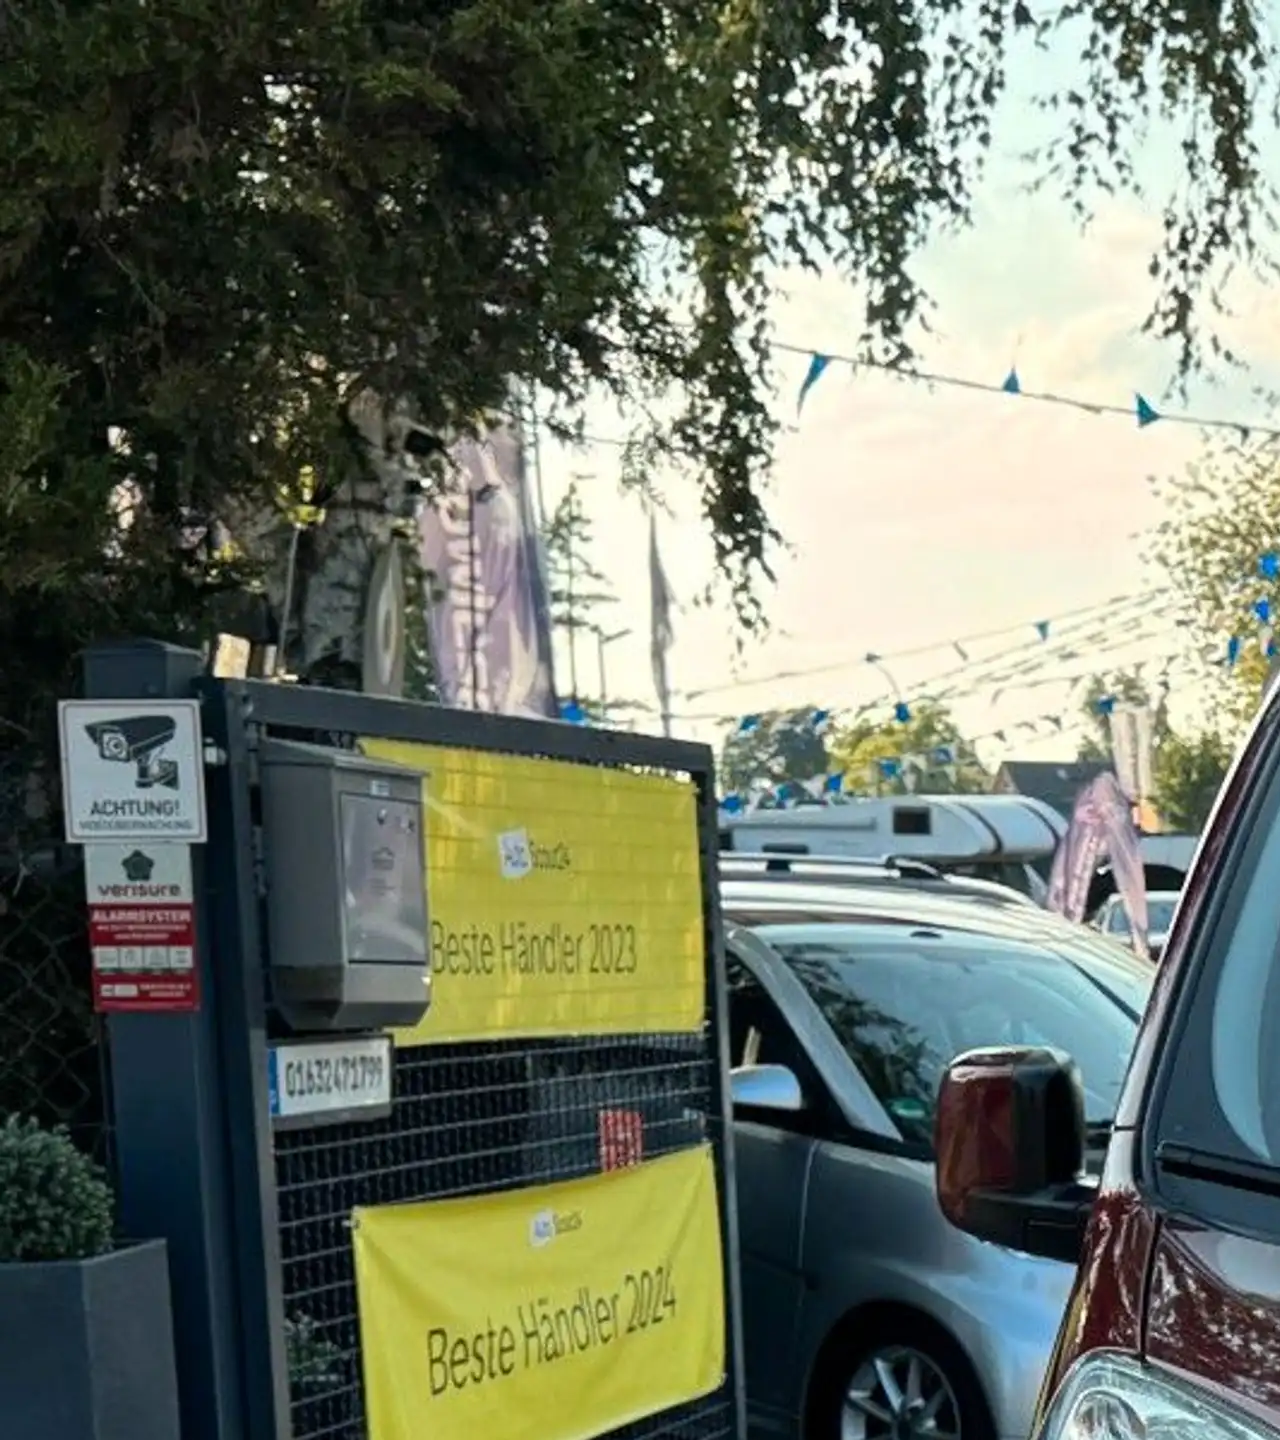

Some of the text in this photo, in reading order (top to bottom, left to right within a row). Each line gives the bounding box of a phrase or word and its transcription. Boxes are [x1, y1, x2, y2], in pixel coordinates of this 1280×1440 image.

[90, 798, 180, 817] ACHTUNG!
[98, 883, 181, 898] verisure
[431, 920, 638, 976] Beste Händler 2023
[427, 1261, 677, 1397] Beste Händler 2024
